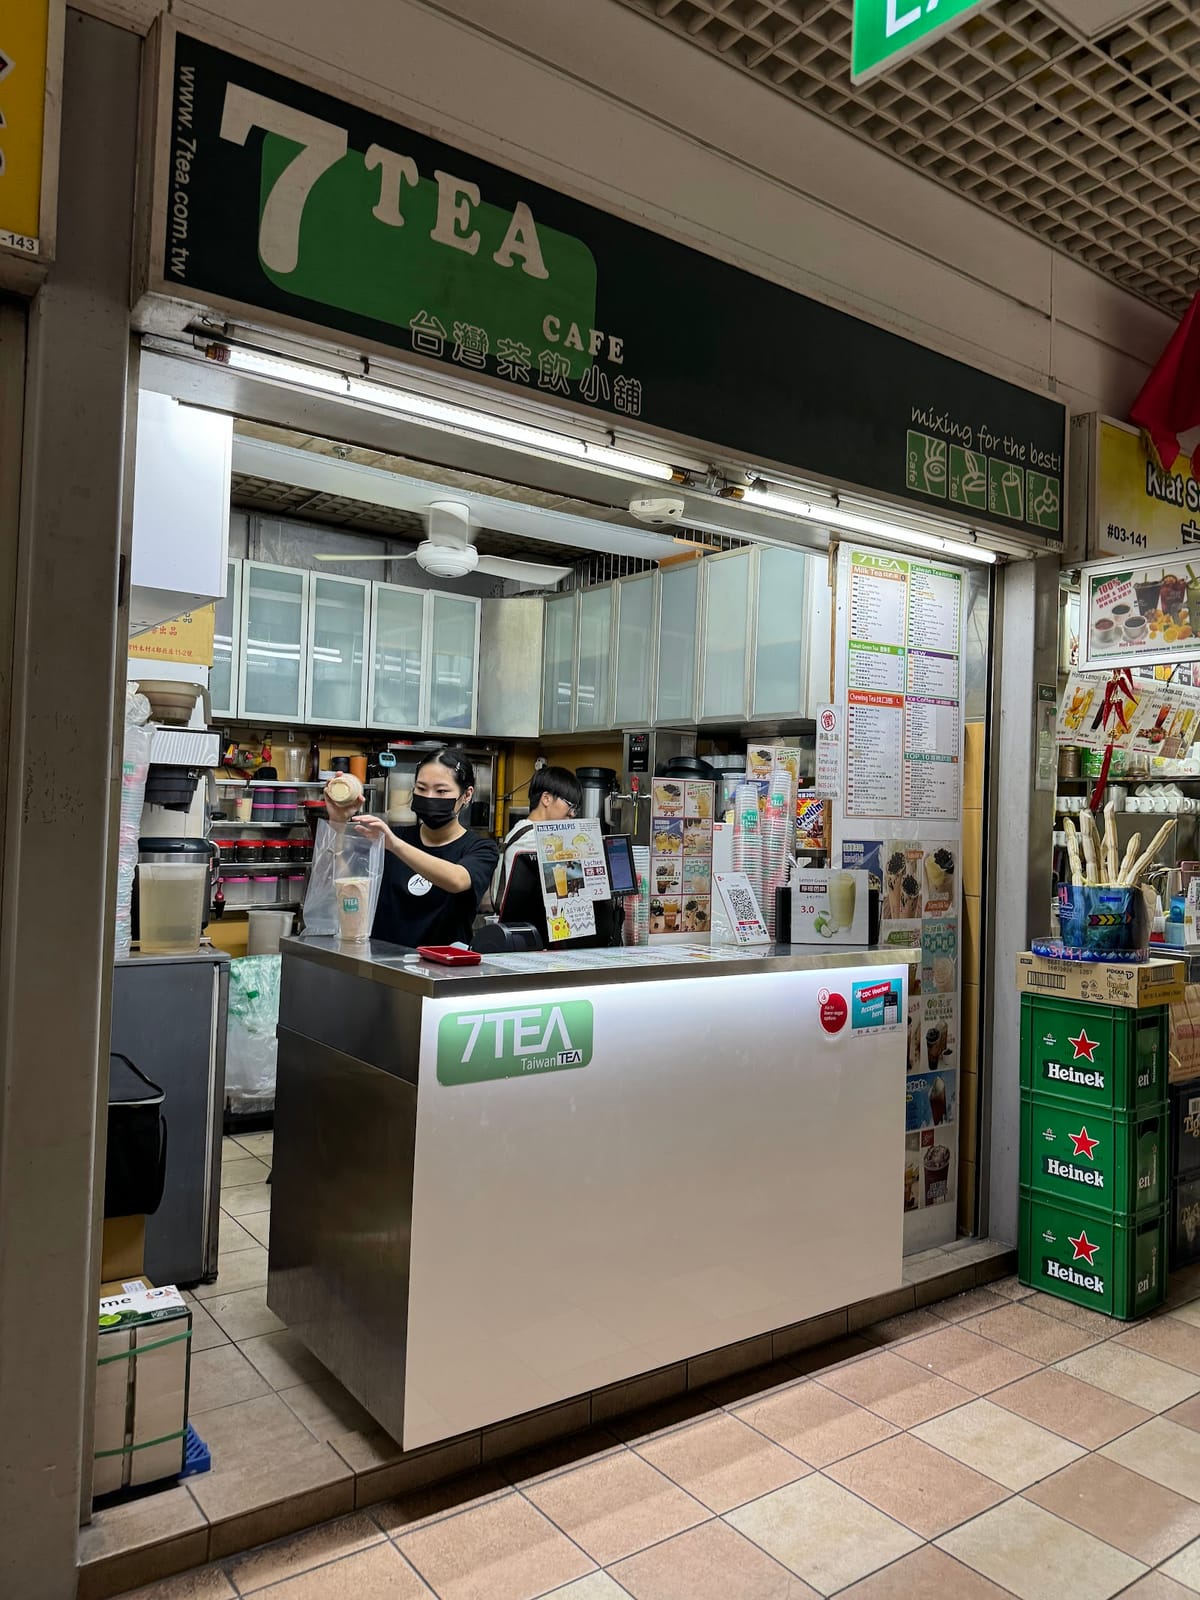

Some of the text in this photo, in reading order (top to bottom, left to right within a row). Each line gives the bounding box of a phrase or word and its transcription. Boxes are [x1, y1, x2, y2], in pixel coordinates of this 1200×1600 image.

[169, 65, 197, 278] www.7tea.com.tw
[542, 315, 624, 364] CAFE
[911, 406, 1061, 472] mixing for the best!
[951, 475, 960, 498] Tea
[1186, 477, 1200, 511] S
[1107, 523, 1148, 549] #03-141
[857, 553, 902, 570] 7TEA
[1098, 577, 1121, 595] 100%
[800, 905, 815, 914] 3.0
[872, 985, 889, 995] Voucher
[457, 1006, 573, 1064] 7TEA
[521, 1051, 581, 1071] Taiwan TEA
[1047, 1062, 1105, 1089] Heinek
[1047, 1158, 1104, 1188] Heinek
[1047, 1260, 1104, 1295] Heinek
